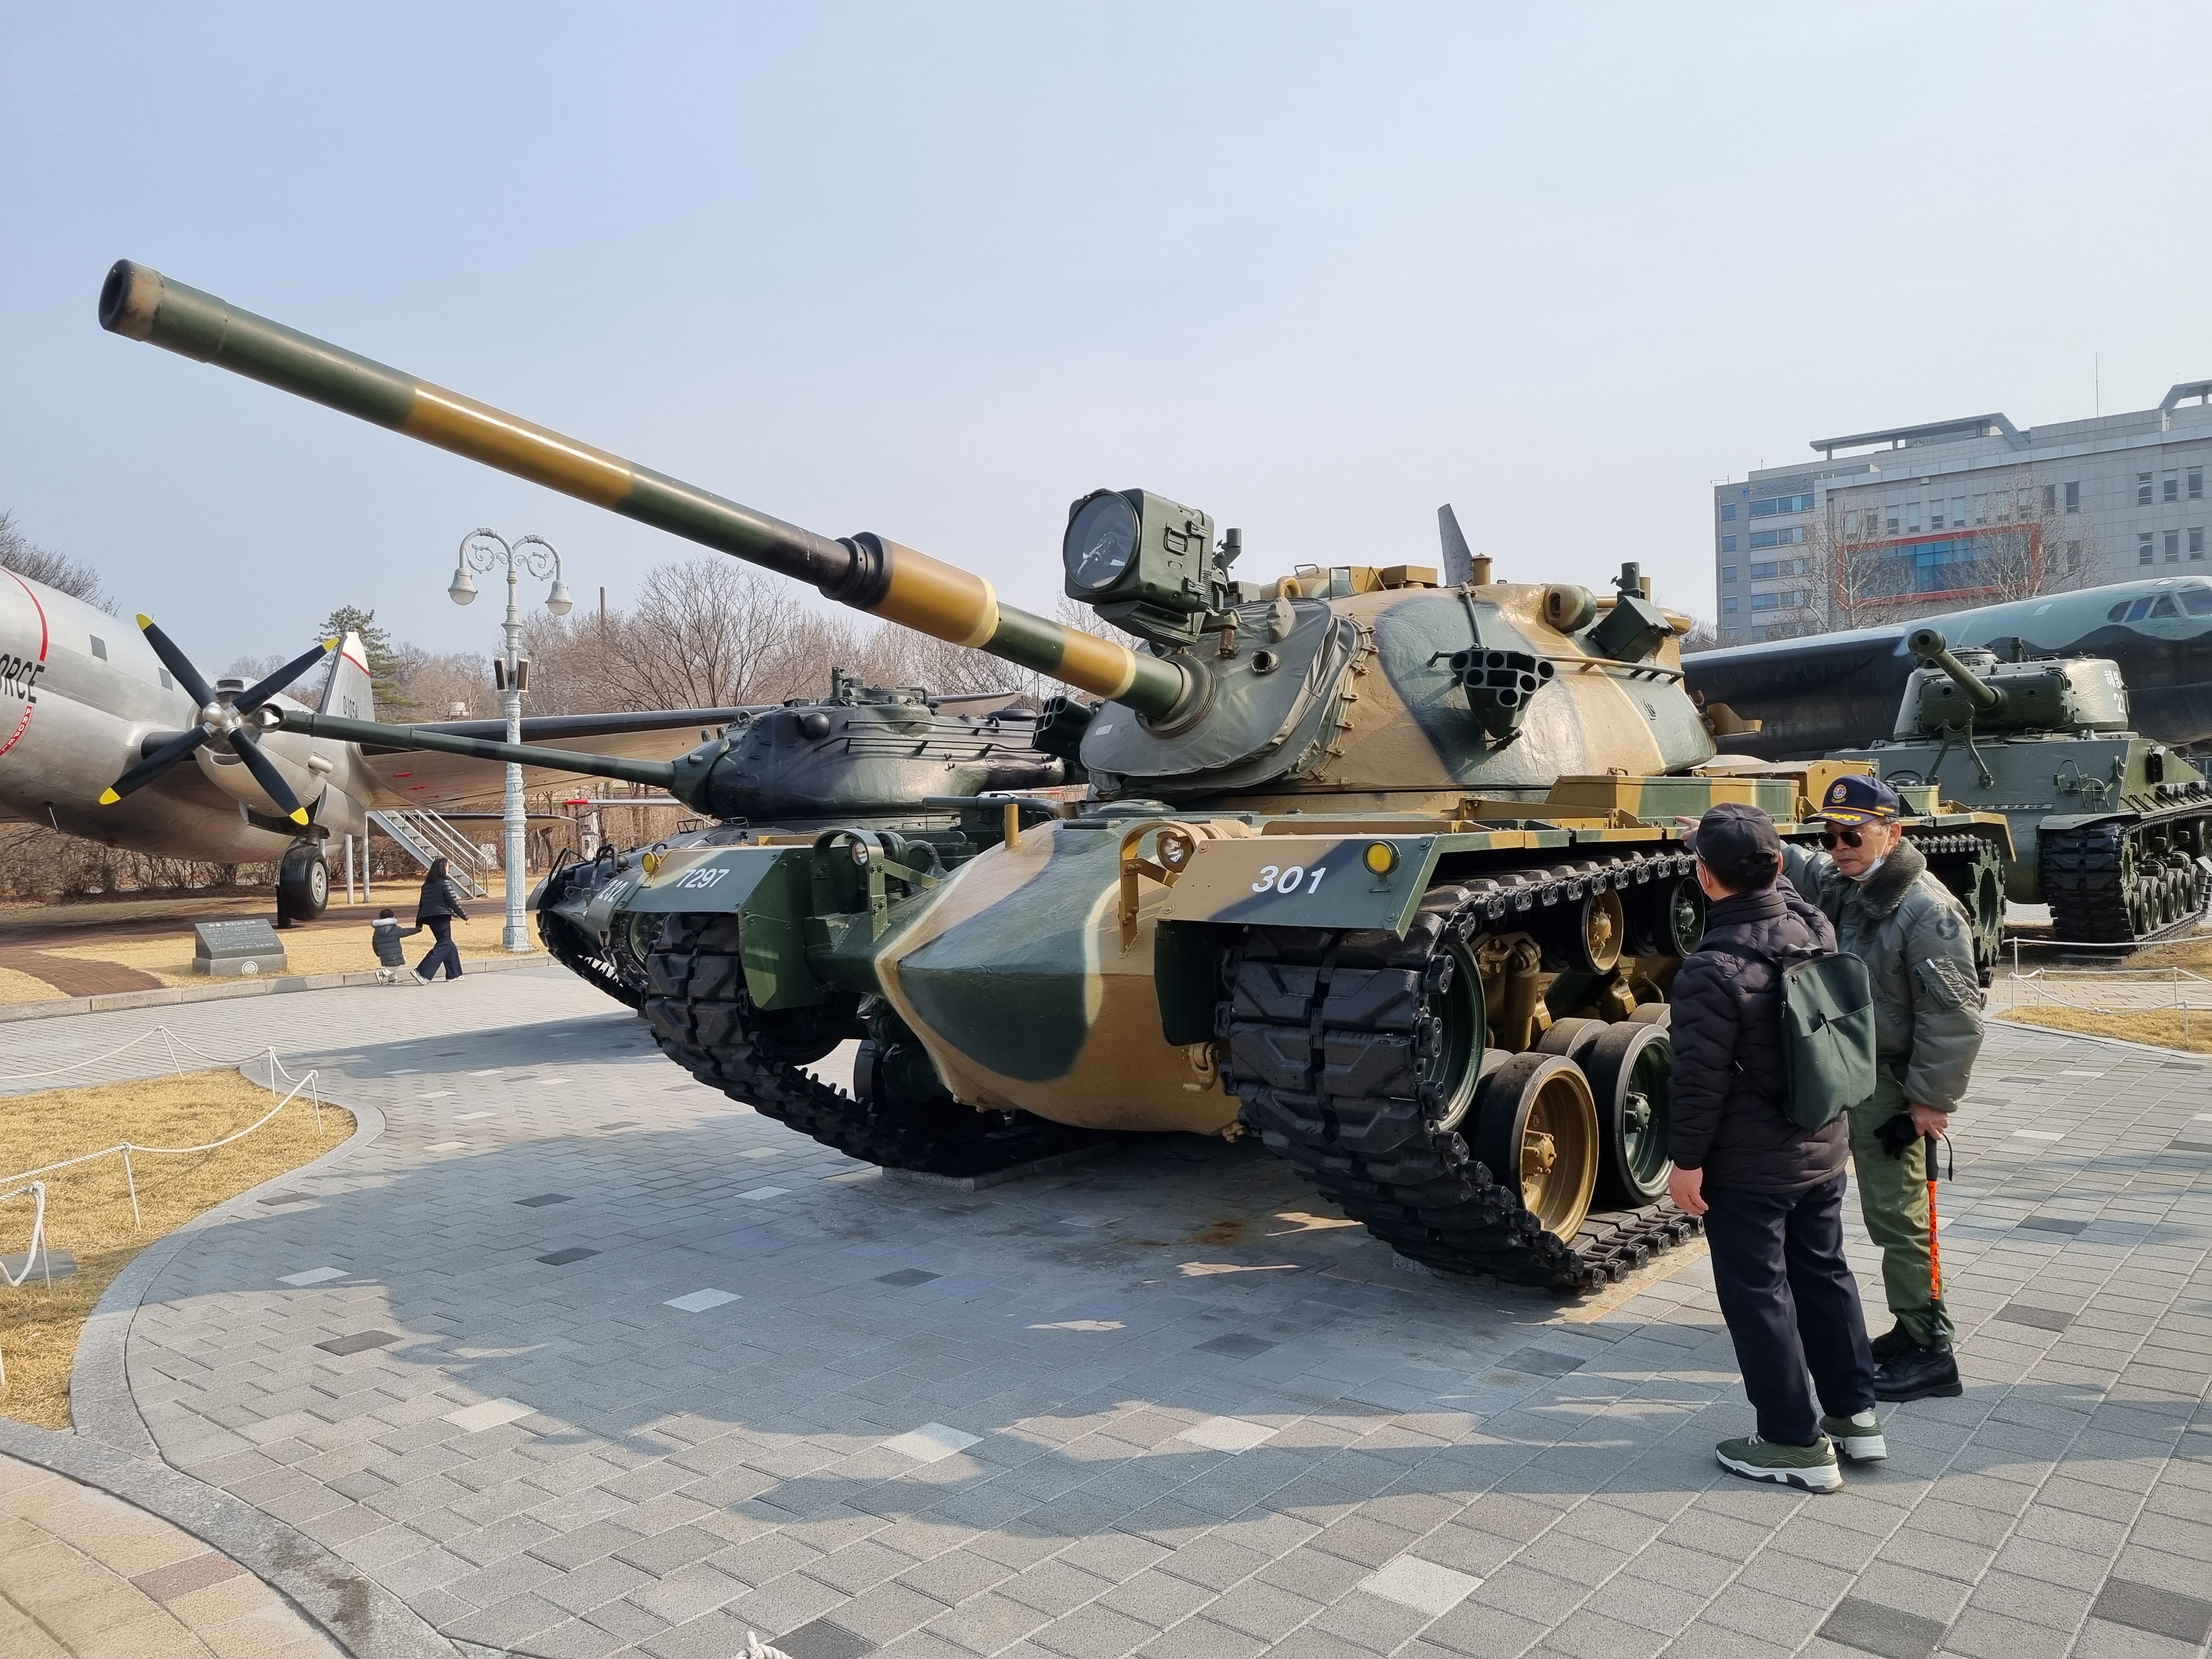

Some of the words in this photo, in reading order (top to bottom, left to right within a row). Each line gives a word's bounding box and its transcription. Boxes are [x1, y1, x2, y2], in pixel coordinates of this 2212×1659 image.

[2104, 670, 2121, 689] 해병
[676, 868, 731, 888] 7297
[1252, 865, 1327, 894] 301
[597, 879, 629, 903] 232
